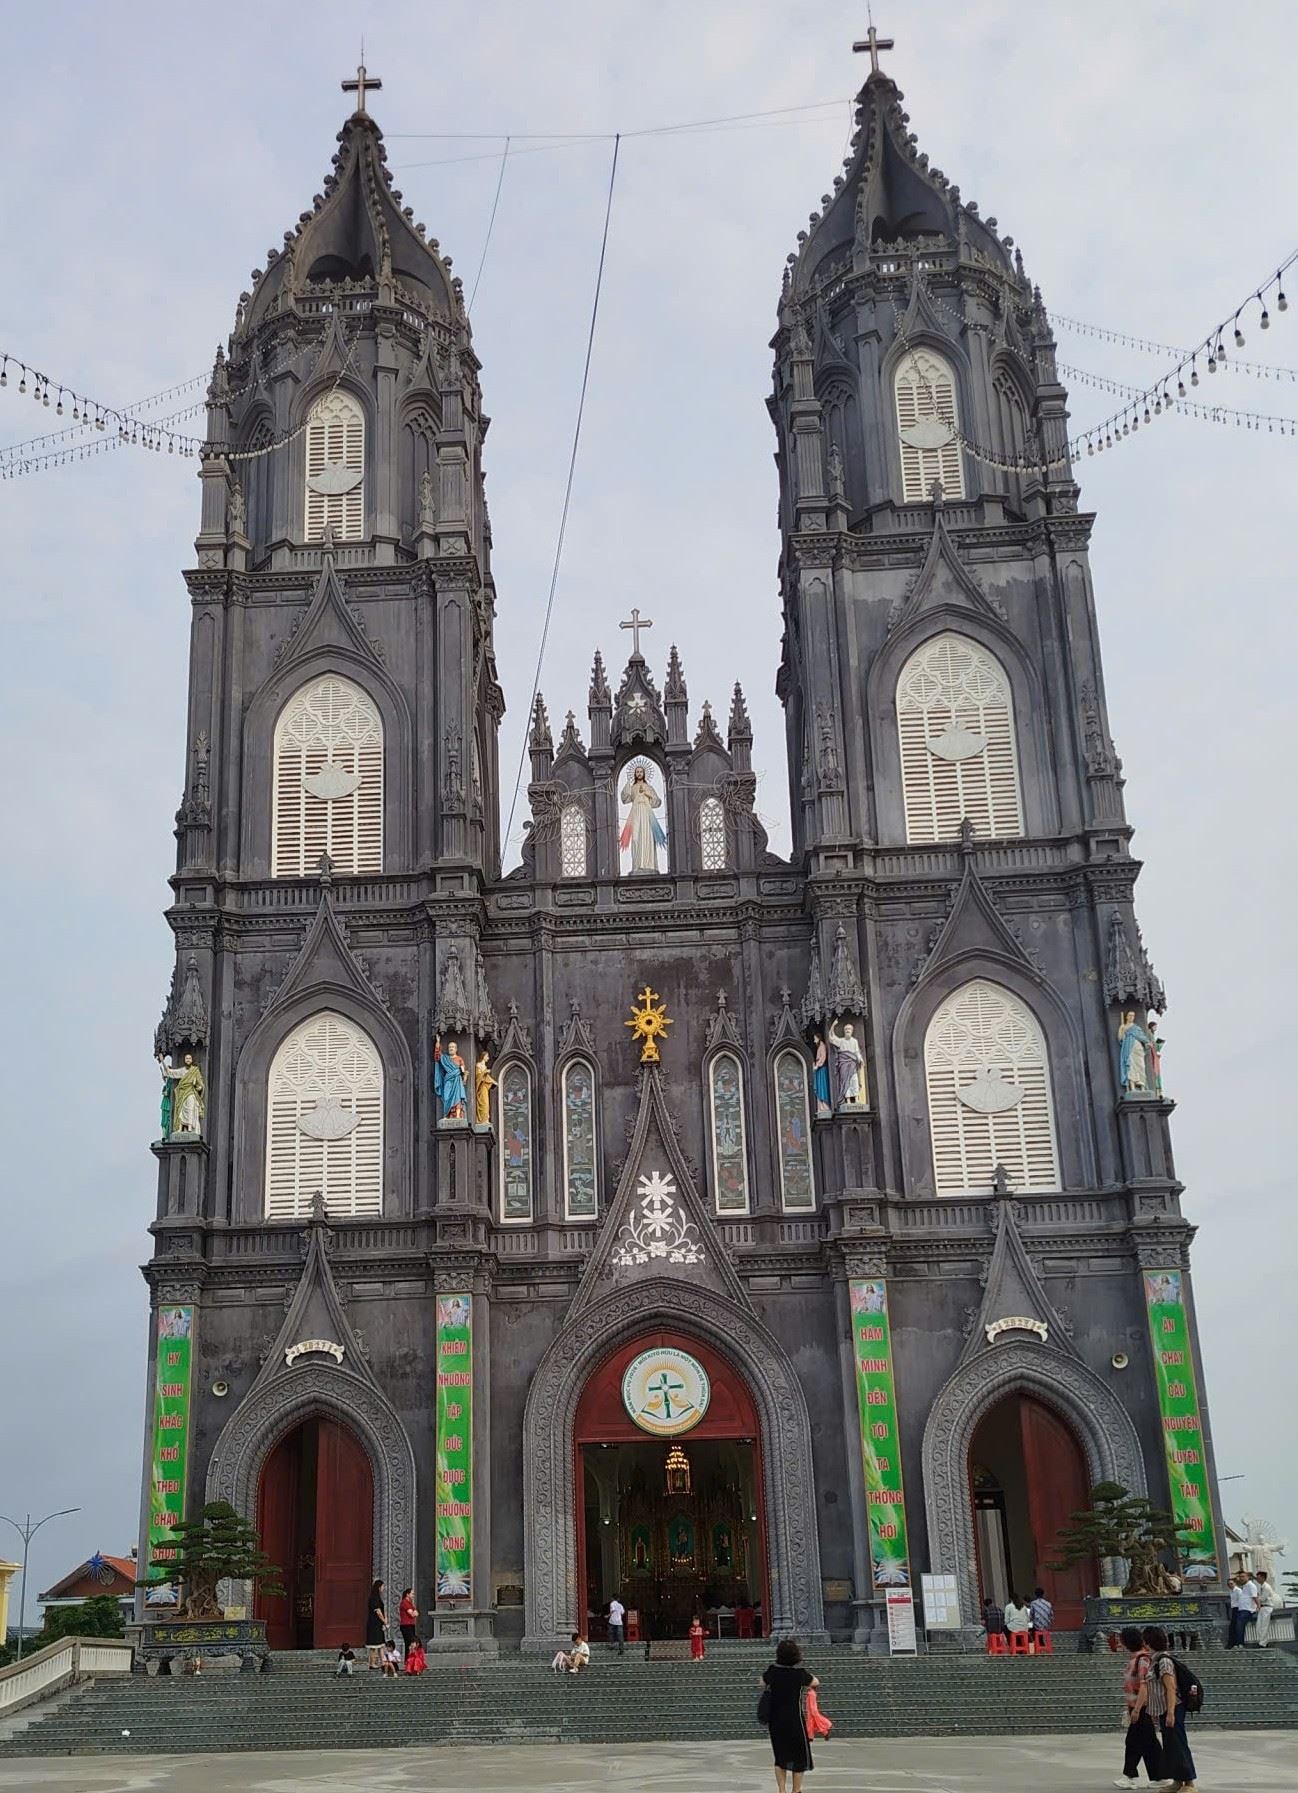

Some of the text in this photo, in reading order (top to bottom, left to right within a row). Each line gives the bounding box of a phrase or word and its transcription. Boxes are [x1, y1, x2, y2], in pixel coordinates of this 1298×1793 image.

[168, 1351, 181, 1365] HY
[1162, 1350, 1184, 1364] CHAY
[161, 1384, 183, 1397] SINH
[156, 1480, 179, 1493] THEO
